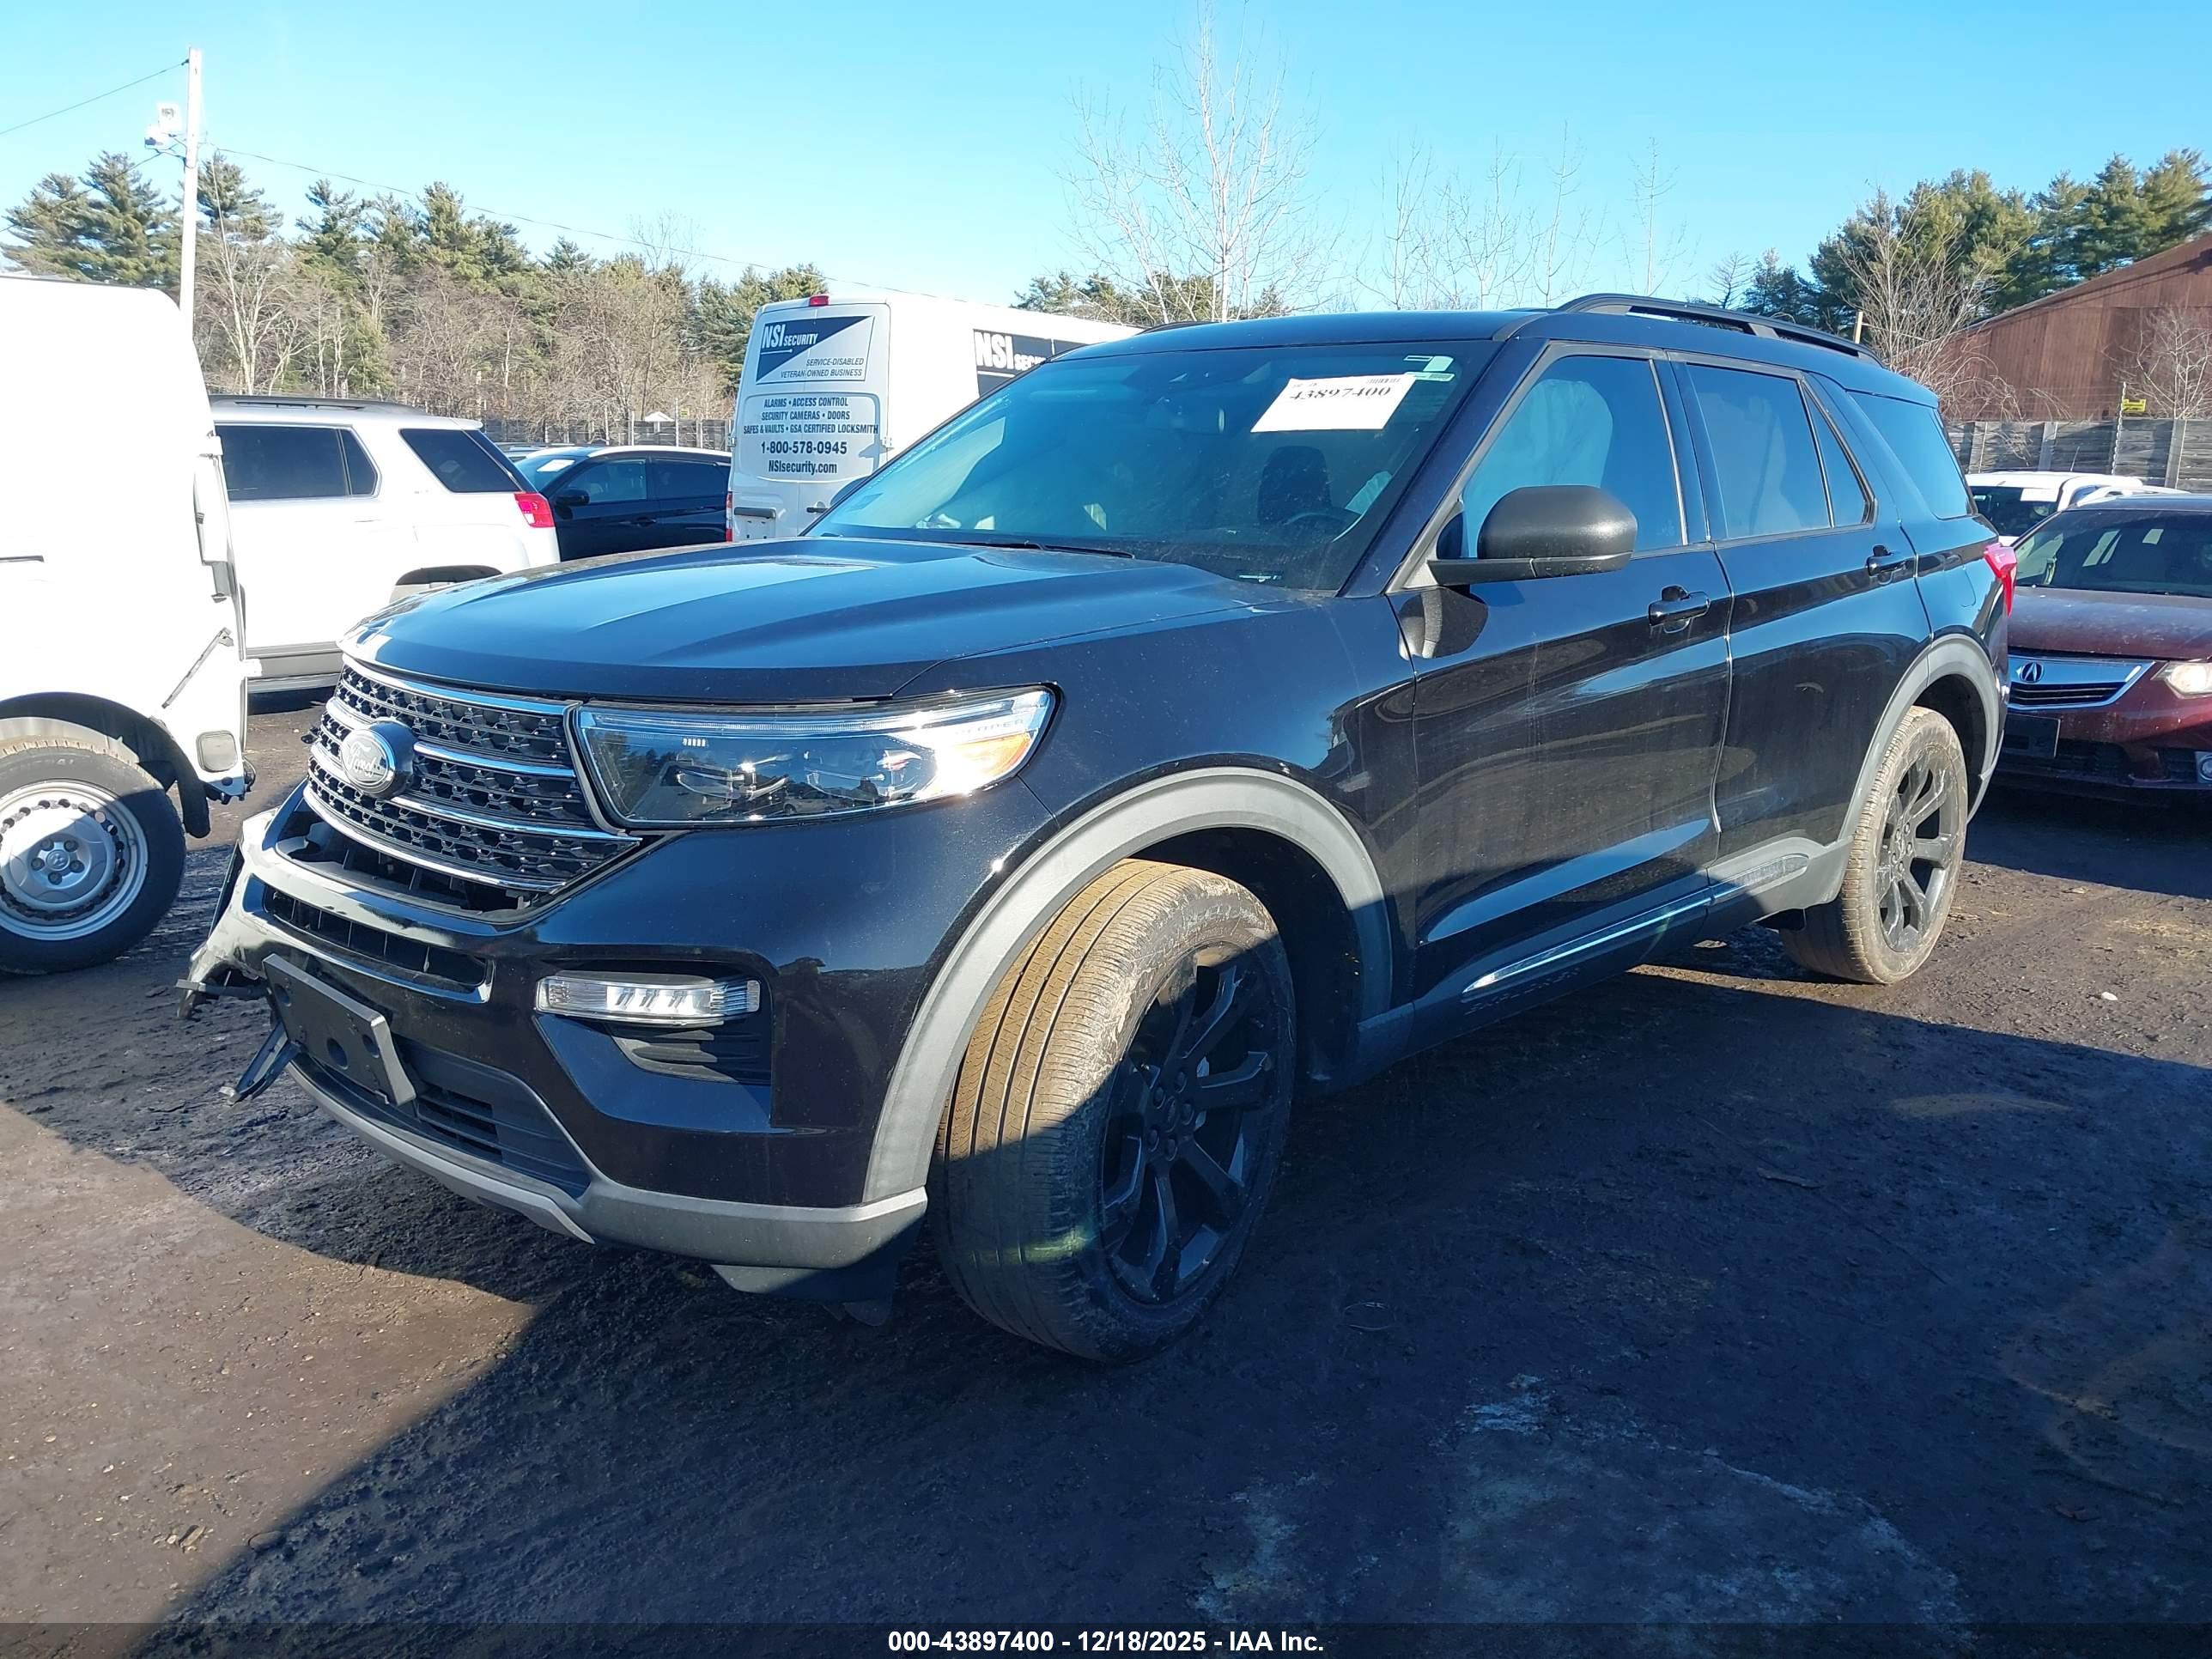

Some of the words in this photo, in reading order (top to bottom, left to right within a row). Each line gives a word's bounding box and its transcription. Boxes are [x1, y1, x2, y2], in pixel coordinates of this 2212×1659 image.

[762, 324, 786, 349] NSI
[784, 333, 818, 346] SECURITY
[974, 331, 1015, 369] NSI
[805, 357, 865, 367] SERVICE-DISABLED
[781, 369, 829, 379] VETERAN-OWNED
[830, 368, 862, 377] BUSINESS
[1290, 386, 1391, 400] 43897400
[763, 398, 787, 408] ALARMS
[792, 398, 817, 407] ACCESS
[818, 398, 848, 407] CONTROL
[761, 411, 788, 421] SECURITY
[789, 410, 820, 420] CAMERAS
[827, 410, 850, 420] DOORS
[744, 425, 759, 434] SAFES
[759, 425, 764, 434] &
[763, 424, 785, 434] VAULTS
[790, 424, 802, 434] GSA
[803, 424, 836, 434] CERTIFIED
[838, 424, 878, 434] LOCKSMITH
[761, 441, 848, 454] 1-800-578-0945
[769, 460, 837, 476] NSIsecurity.com
[347, 741, 377, 777] Ford
